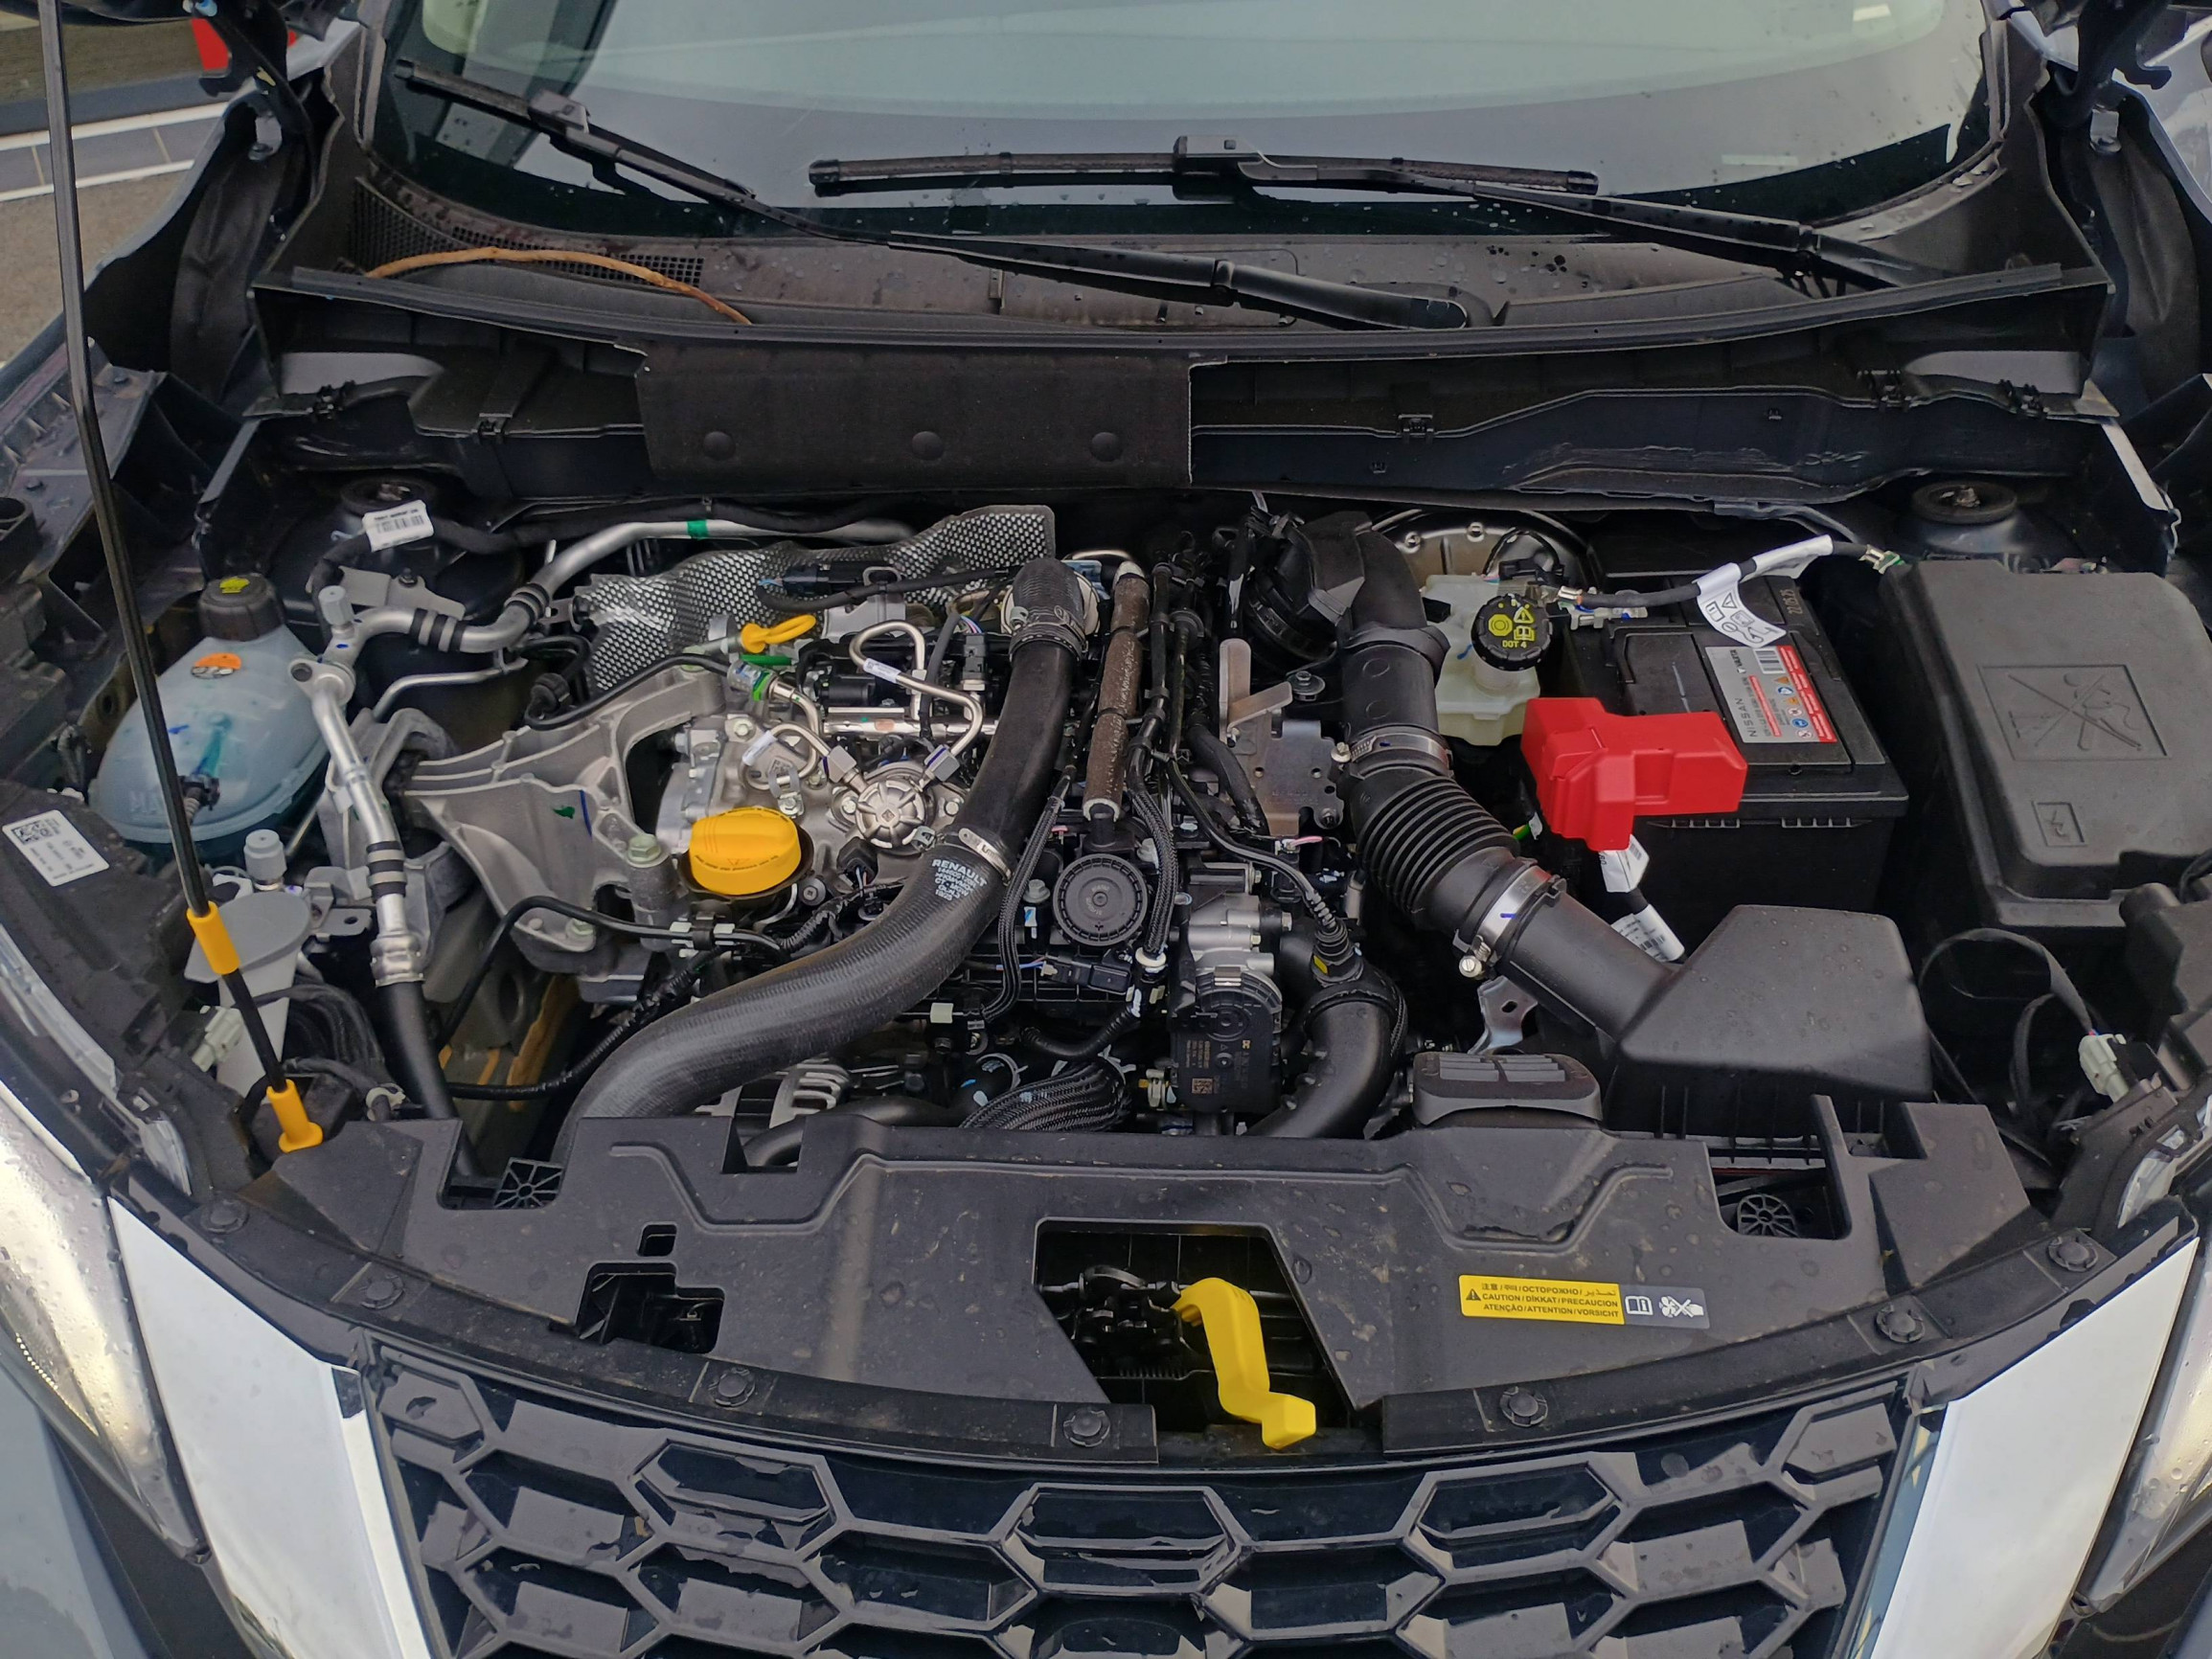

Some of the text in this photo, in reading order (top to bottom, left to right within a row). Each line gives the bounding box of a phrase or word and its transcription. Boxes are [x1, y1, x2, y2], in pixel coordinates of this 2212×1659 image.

[1735, 698, 1758, 738] NISSAN
[932, 859, 987, 886] RENAULT
[1483, 1293, 1520, 1302] CAUTION
[1484, 1303, 1523, 1312] ATENÇÃO
[1527, 1306, 1573, 1315] ATTENTION
[1577, 1308, 1619, 1317] VORSICHT
